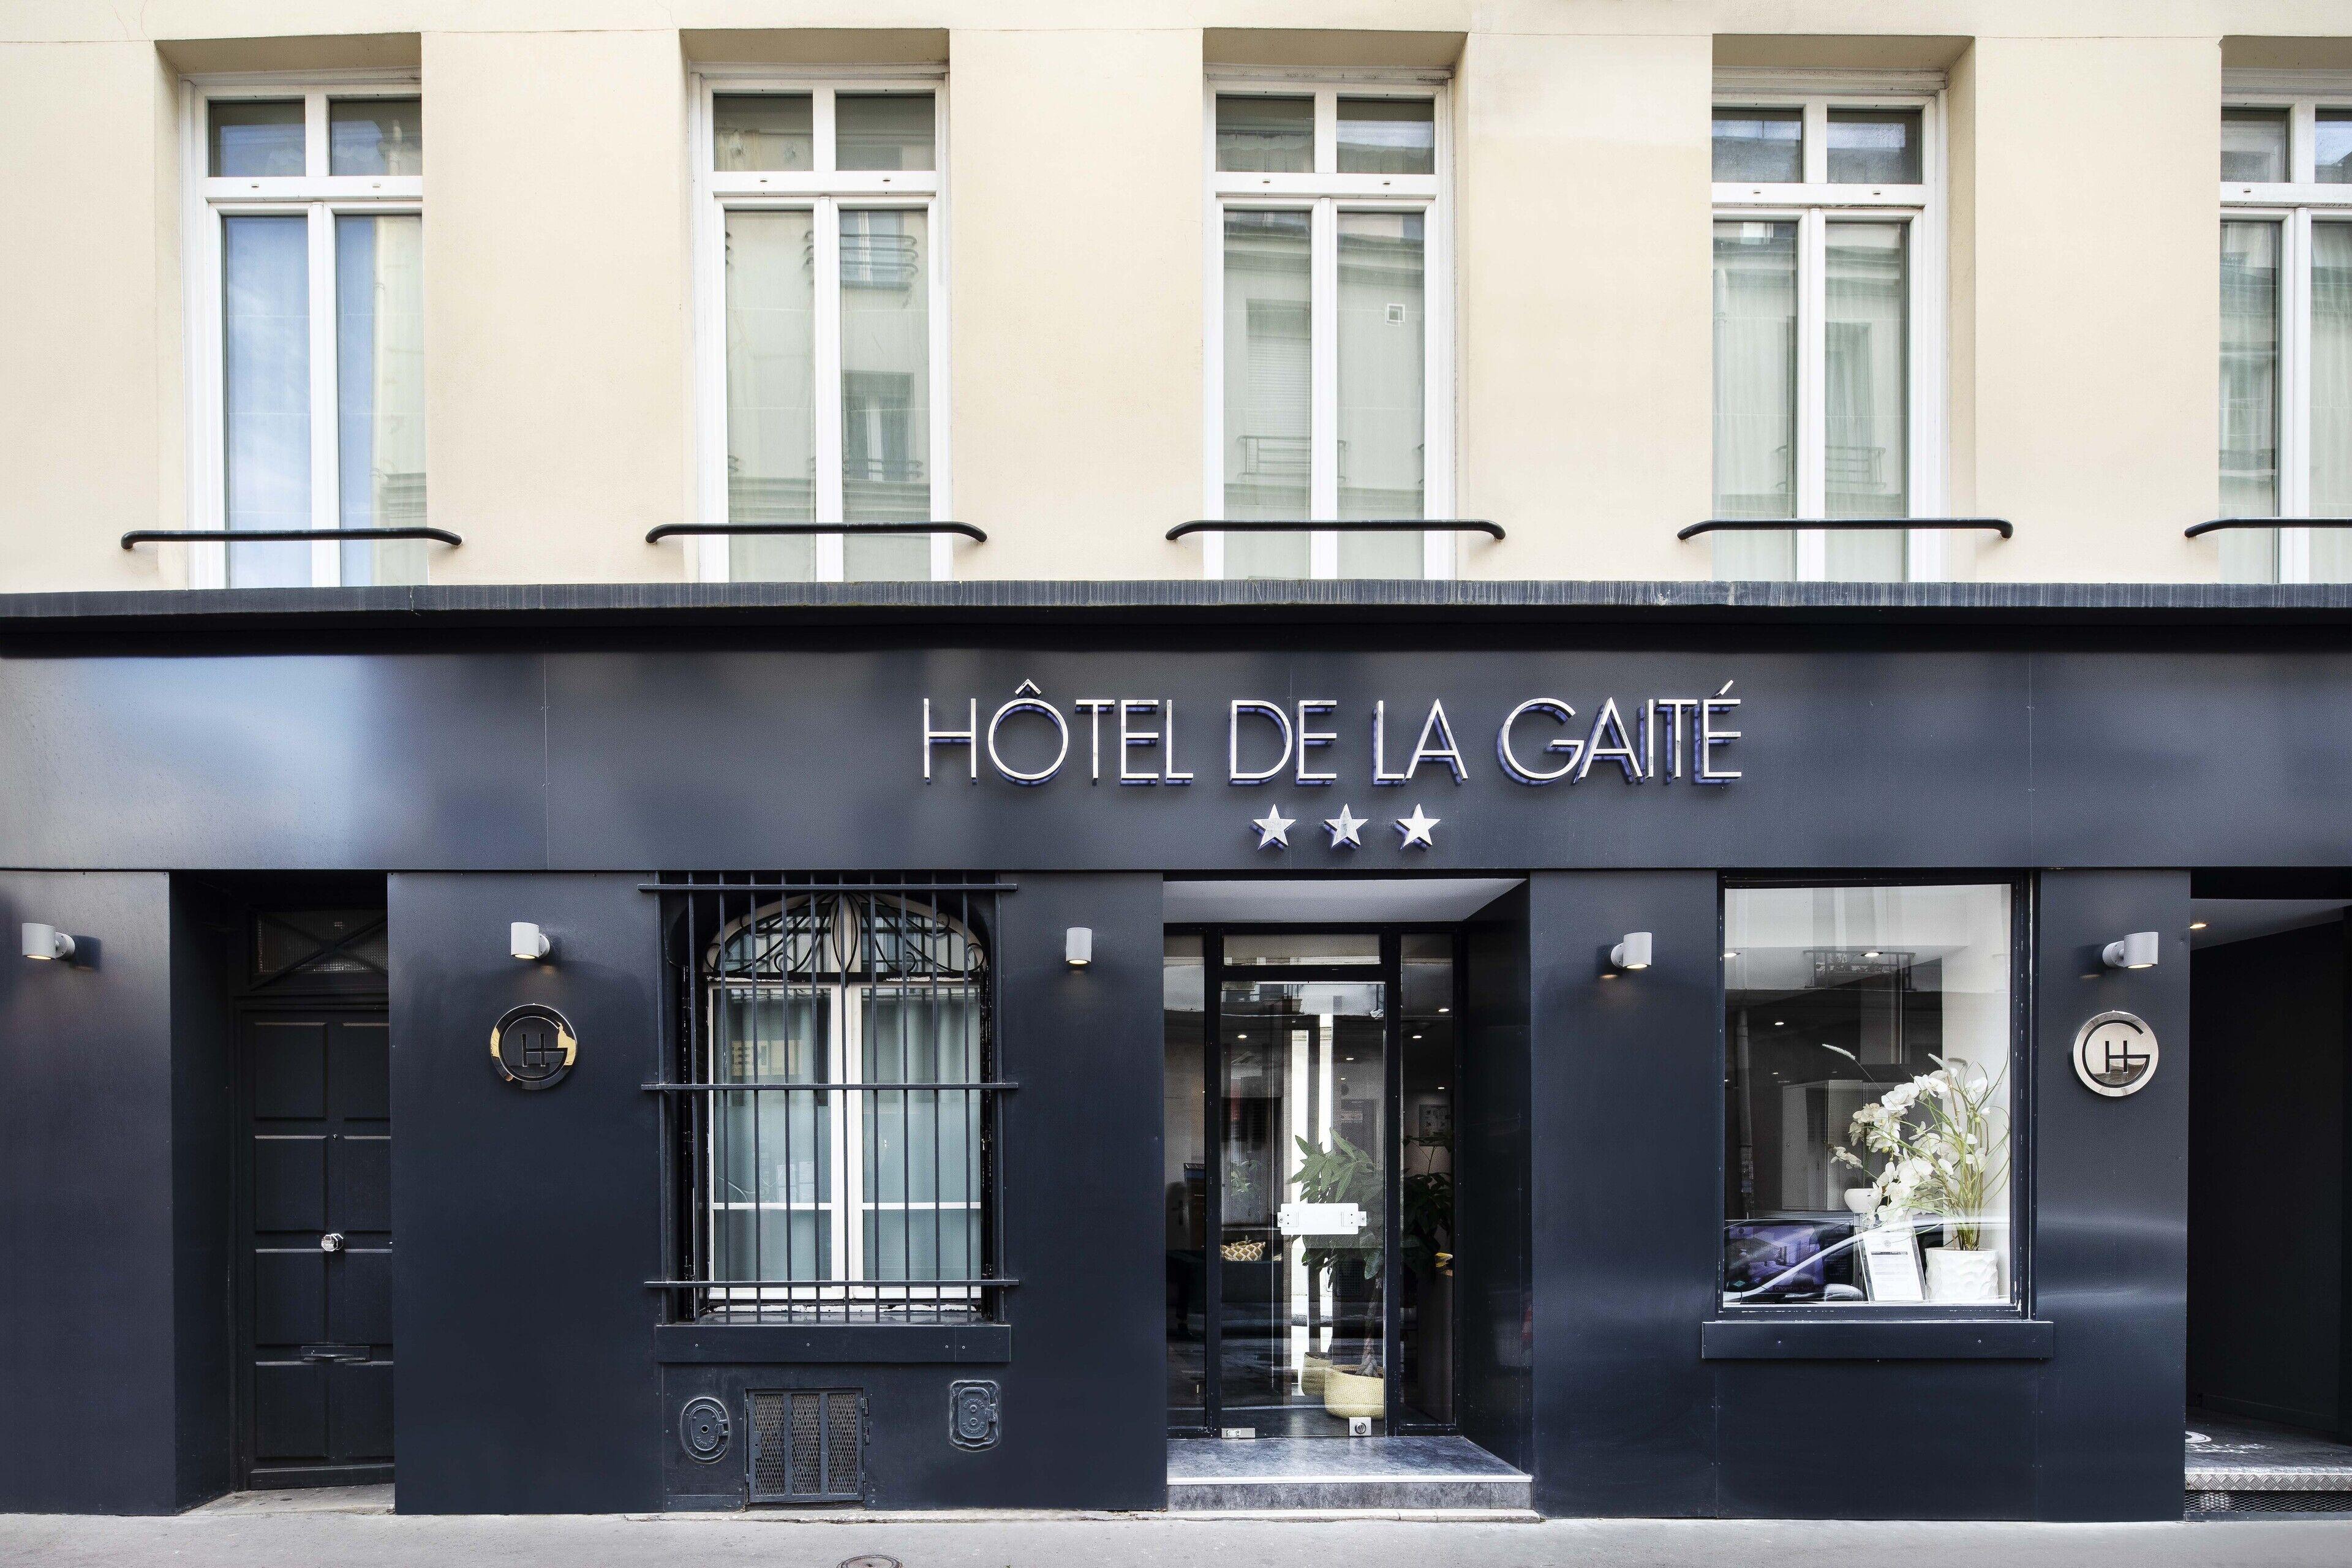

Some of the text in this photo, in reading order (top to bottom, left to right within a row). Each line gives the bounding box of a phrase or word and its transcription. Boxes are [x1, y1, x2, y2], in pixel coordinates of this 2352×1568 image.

[923, 678, 1742, 785] HÔTEL DE LA GAITÉ
